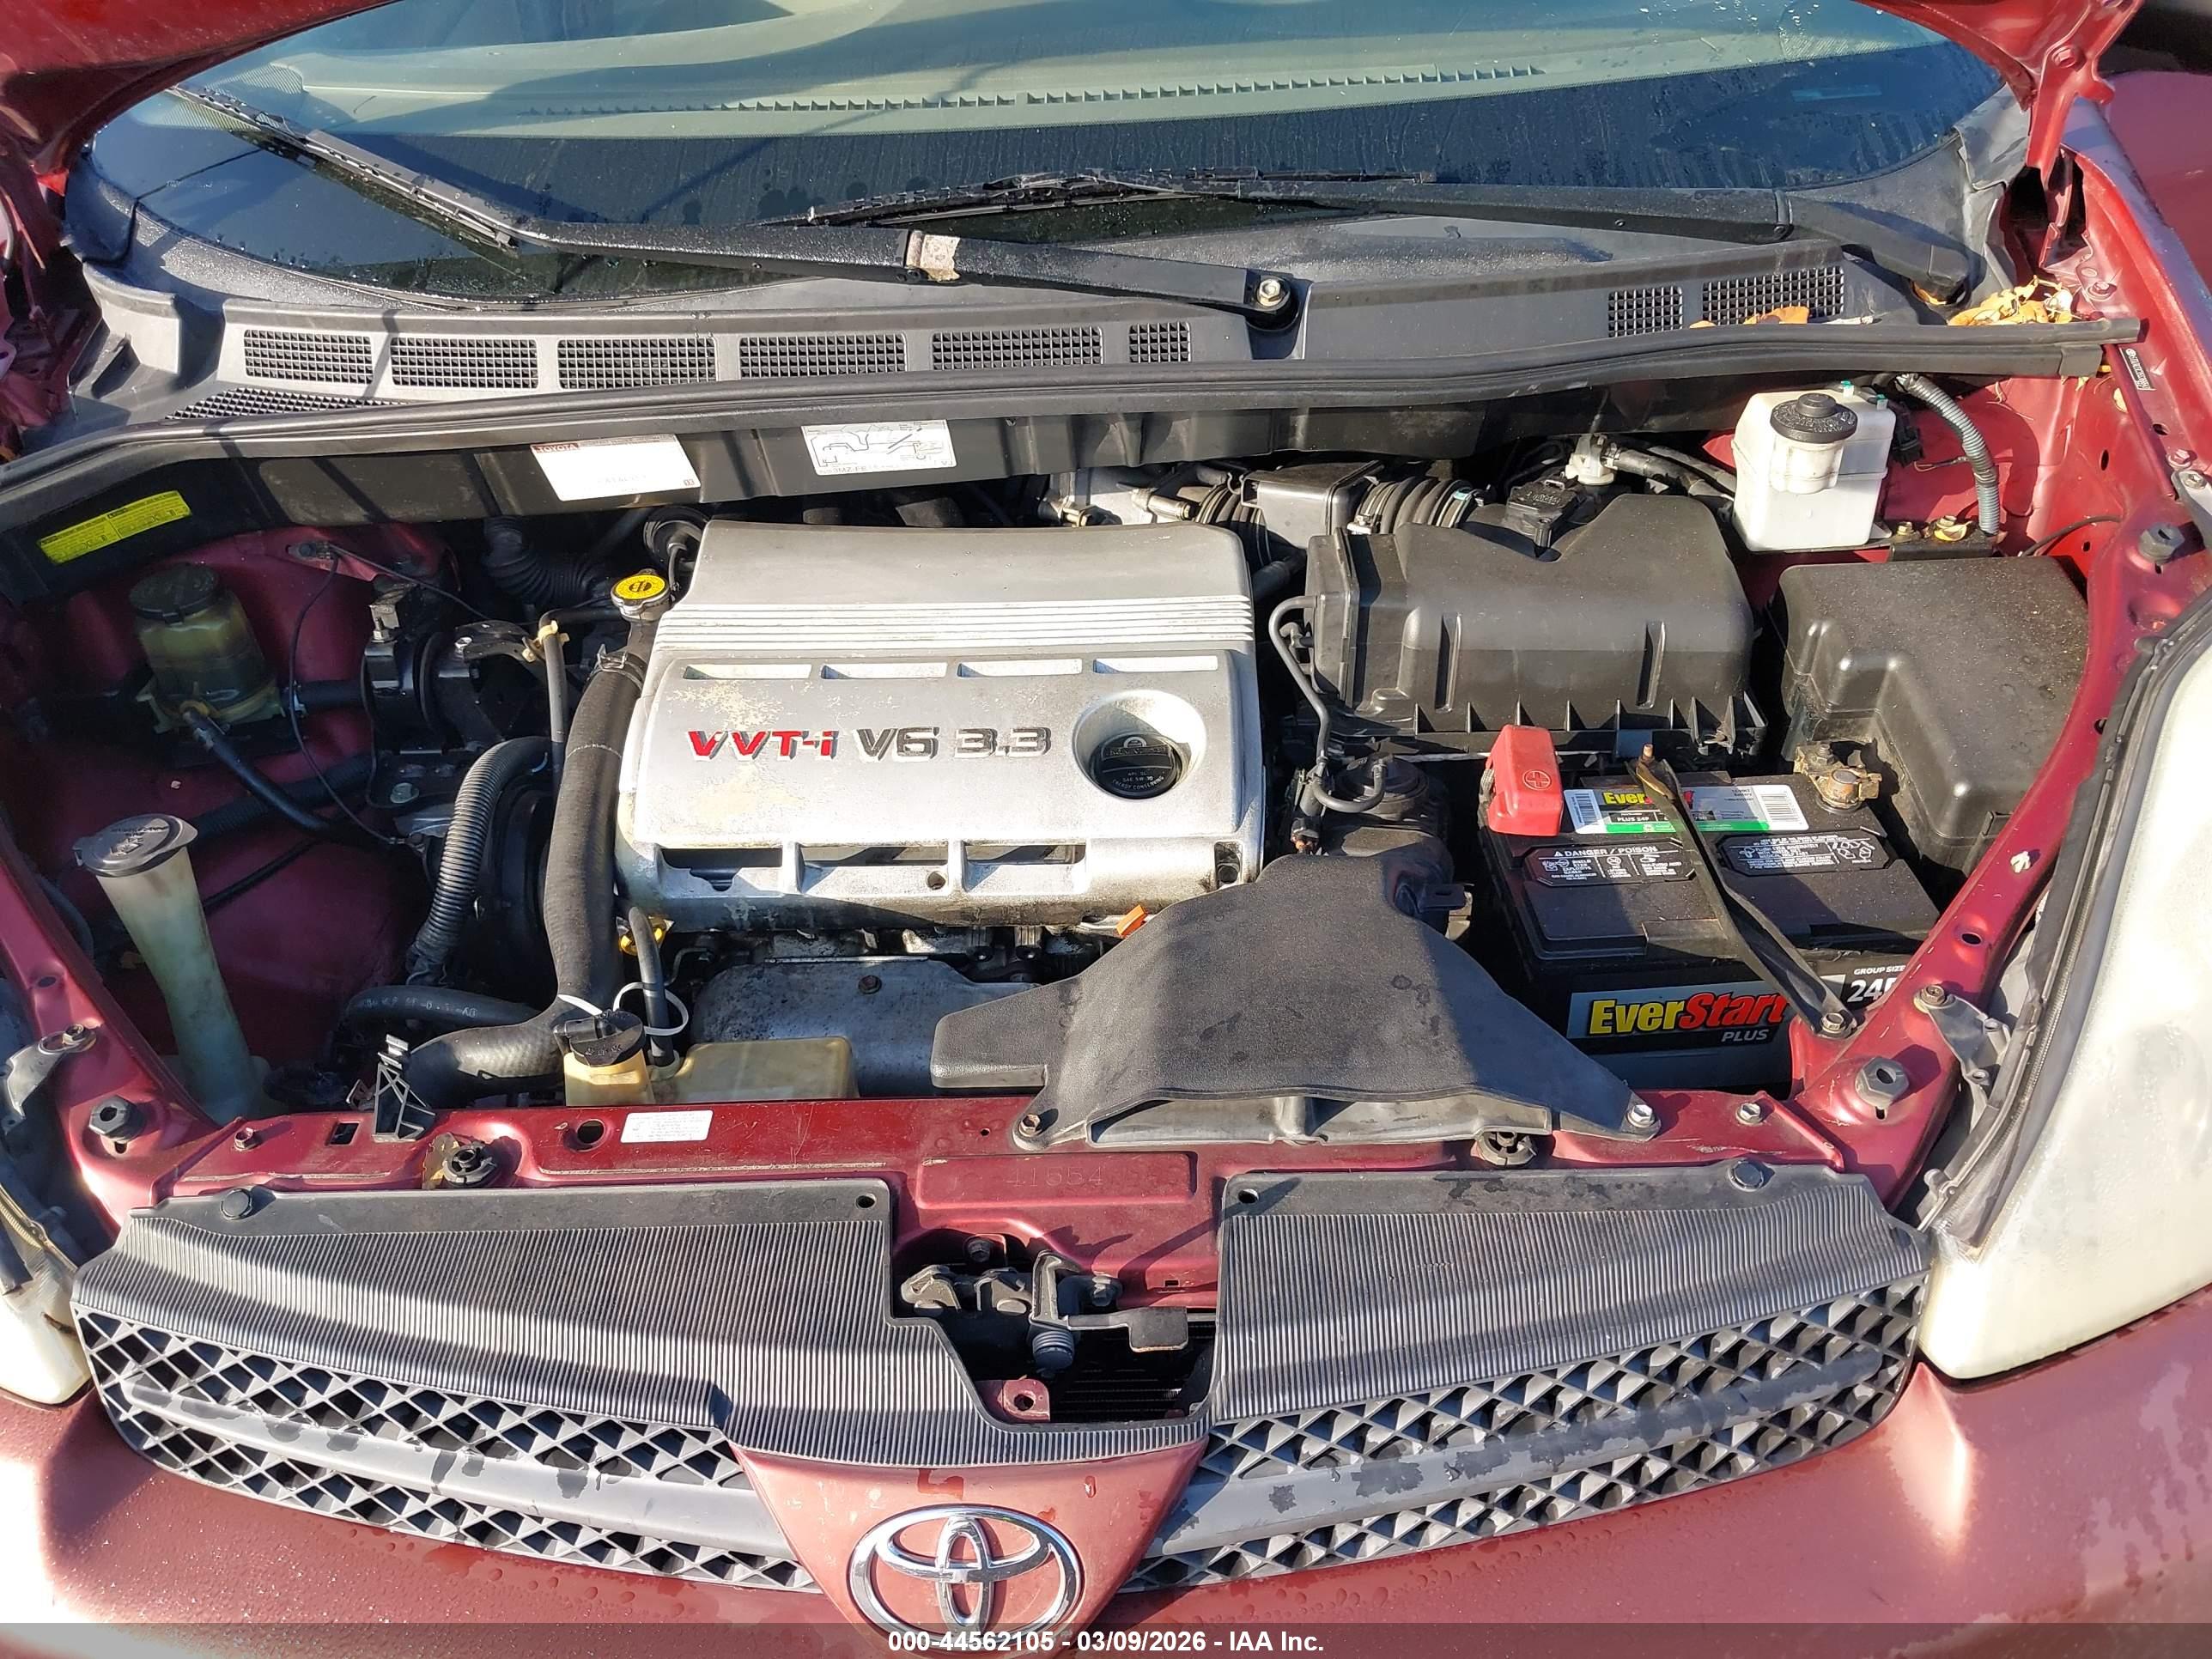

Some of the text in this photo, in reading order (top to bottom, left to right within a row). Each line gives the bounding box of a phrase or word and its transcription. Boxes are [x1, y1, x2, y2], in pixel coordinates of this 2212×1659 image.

[536, 443, 578, 453] TOYOTA
[688, 726, 1053, 763] VVT-i V6 3.3
[1565, 848, 1608, 856] DANGER
[1853, 964, 1906, 975] GROUP SIZE
[1589, 992, 1790, 1036] EverStart
[1721, 1030, 1769, 1042] PLUS
